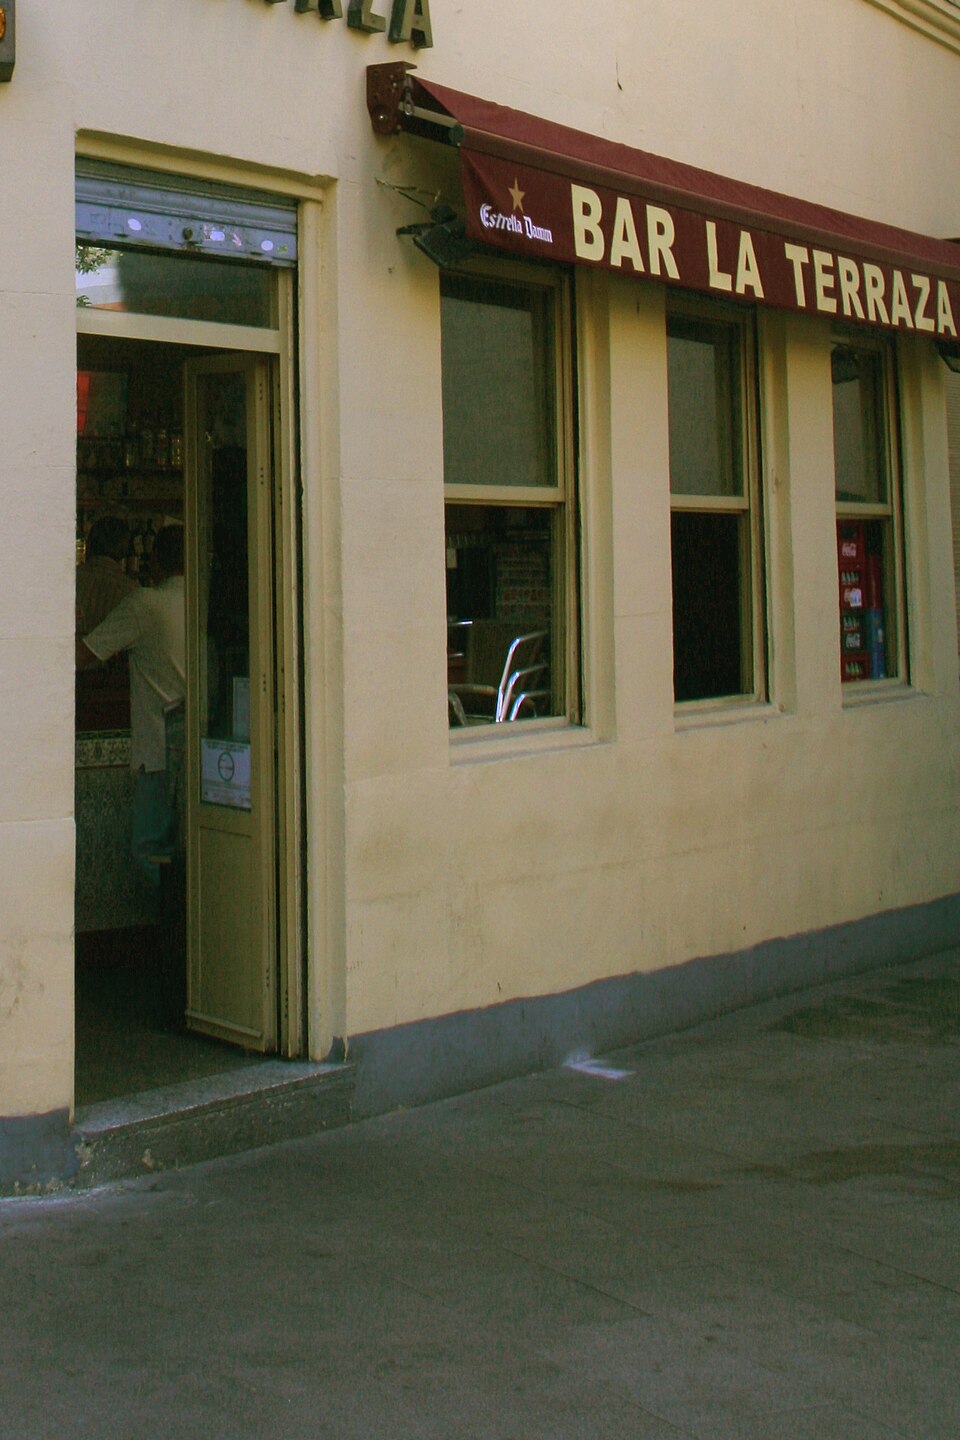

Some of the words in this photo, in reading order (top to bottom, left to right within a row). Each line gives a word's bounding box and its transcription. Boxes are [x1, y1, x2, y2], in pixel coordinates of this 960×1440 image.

[480, 203, 523, 234] Estrella
[523, 215, 553, 243] Damm
[571, 183, 680, 280] BAR
[706, 221, 765, 299] LA
[784, 242, 958, 337] TERRAZA
